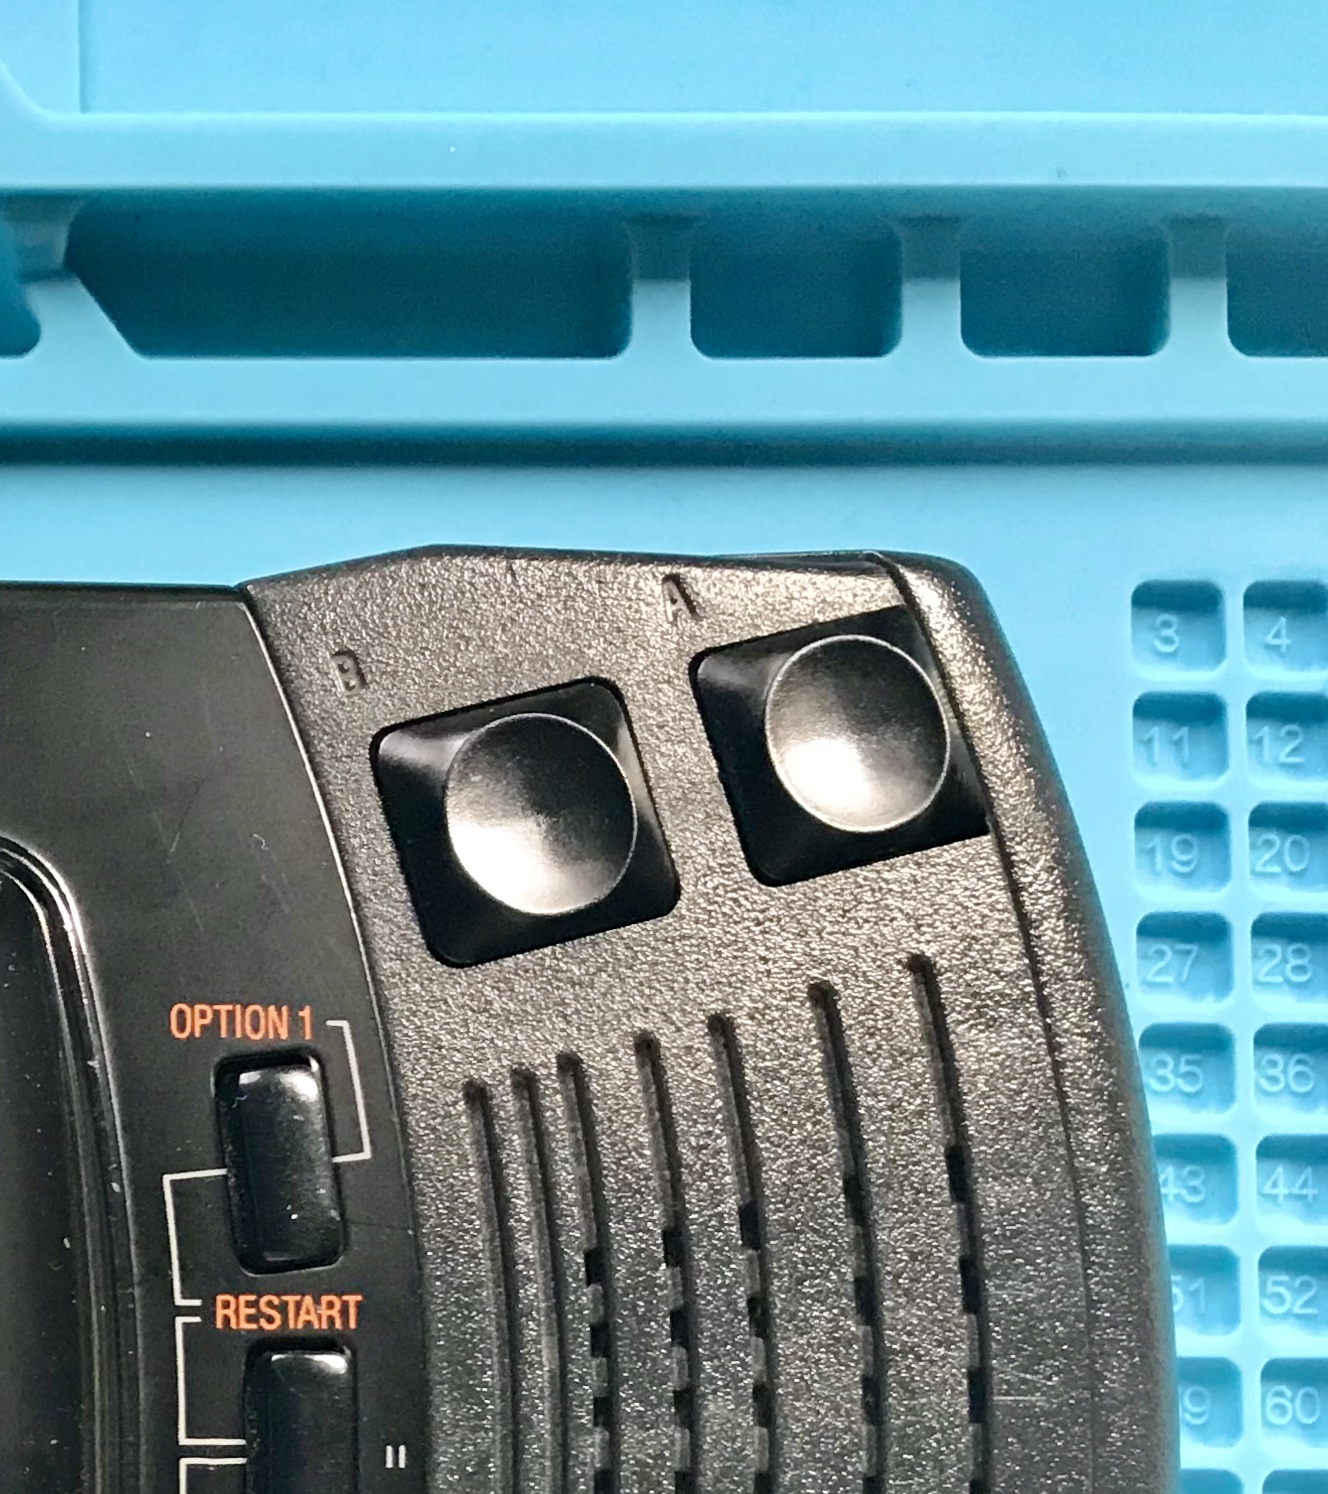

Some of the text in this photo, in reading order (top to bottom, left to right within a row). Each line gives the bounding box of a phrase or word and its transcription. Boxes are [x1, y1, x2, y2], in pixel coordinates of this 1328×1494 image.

[1153, 613, 1181, 654] 3
[1264, 616, 1291, 654] 4
[1144, 726, 1191, 764] 11
[1252, 724, 1305, 764] 12
[1146, 834, 1199, 875] 19
[1254, 834, 1311, 874] 20
[1146, 944, 1201, 984] 27
[1256, 943, 1313, 984] 28
[170, 1003, 313, 1040] OPTION 1
[1148, 1053, 1204, 1093] 35
[1258, 1053, 1316, 1093] 36
[1262, 1166, 1318, 1204] 44
[214, 1294, 363, 1331] RESTART
[1262, 1275, 1319, 1315] 52
[1266, 1385, 1321, 1425] 60
